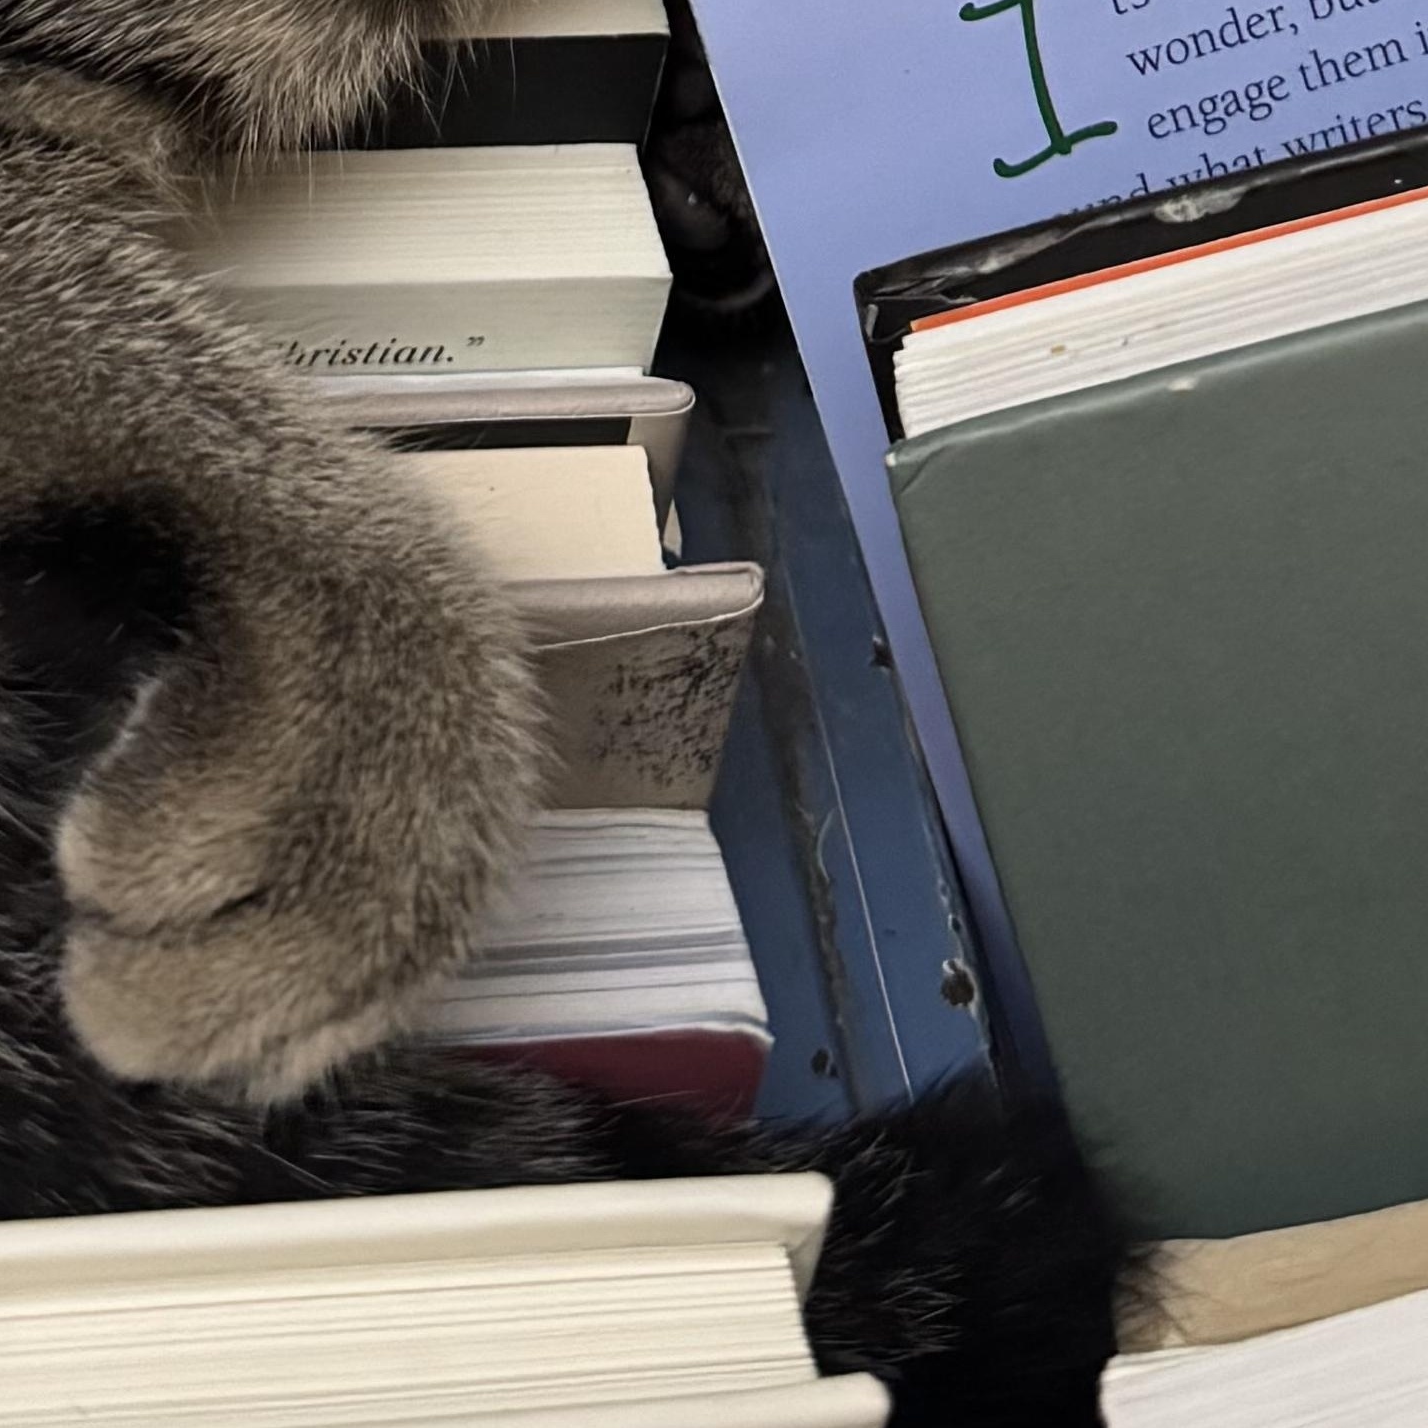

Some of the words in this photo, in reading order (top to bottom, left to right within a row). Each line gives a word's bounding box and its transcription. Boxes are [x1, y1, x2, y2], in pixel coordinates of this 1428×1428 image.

[1126, 6, 1299, 76] wonder,
[1147, 74, 1290, 140] engage
[1299, 29, 1408, 92] them
